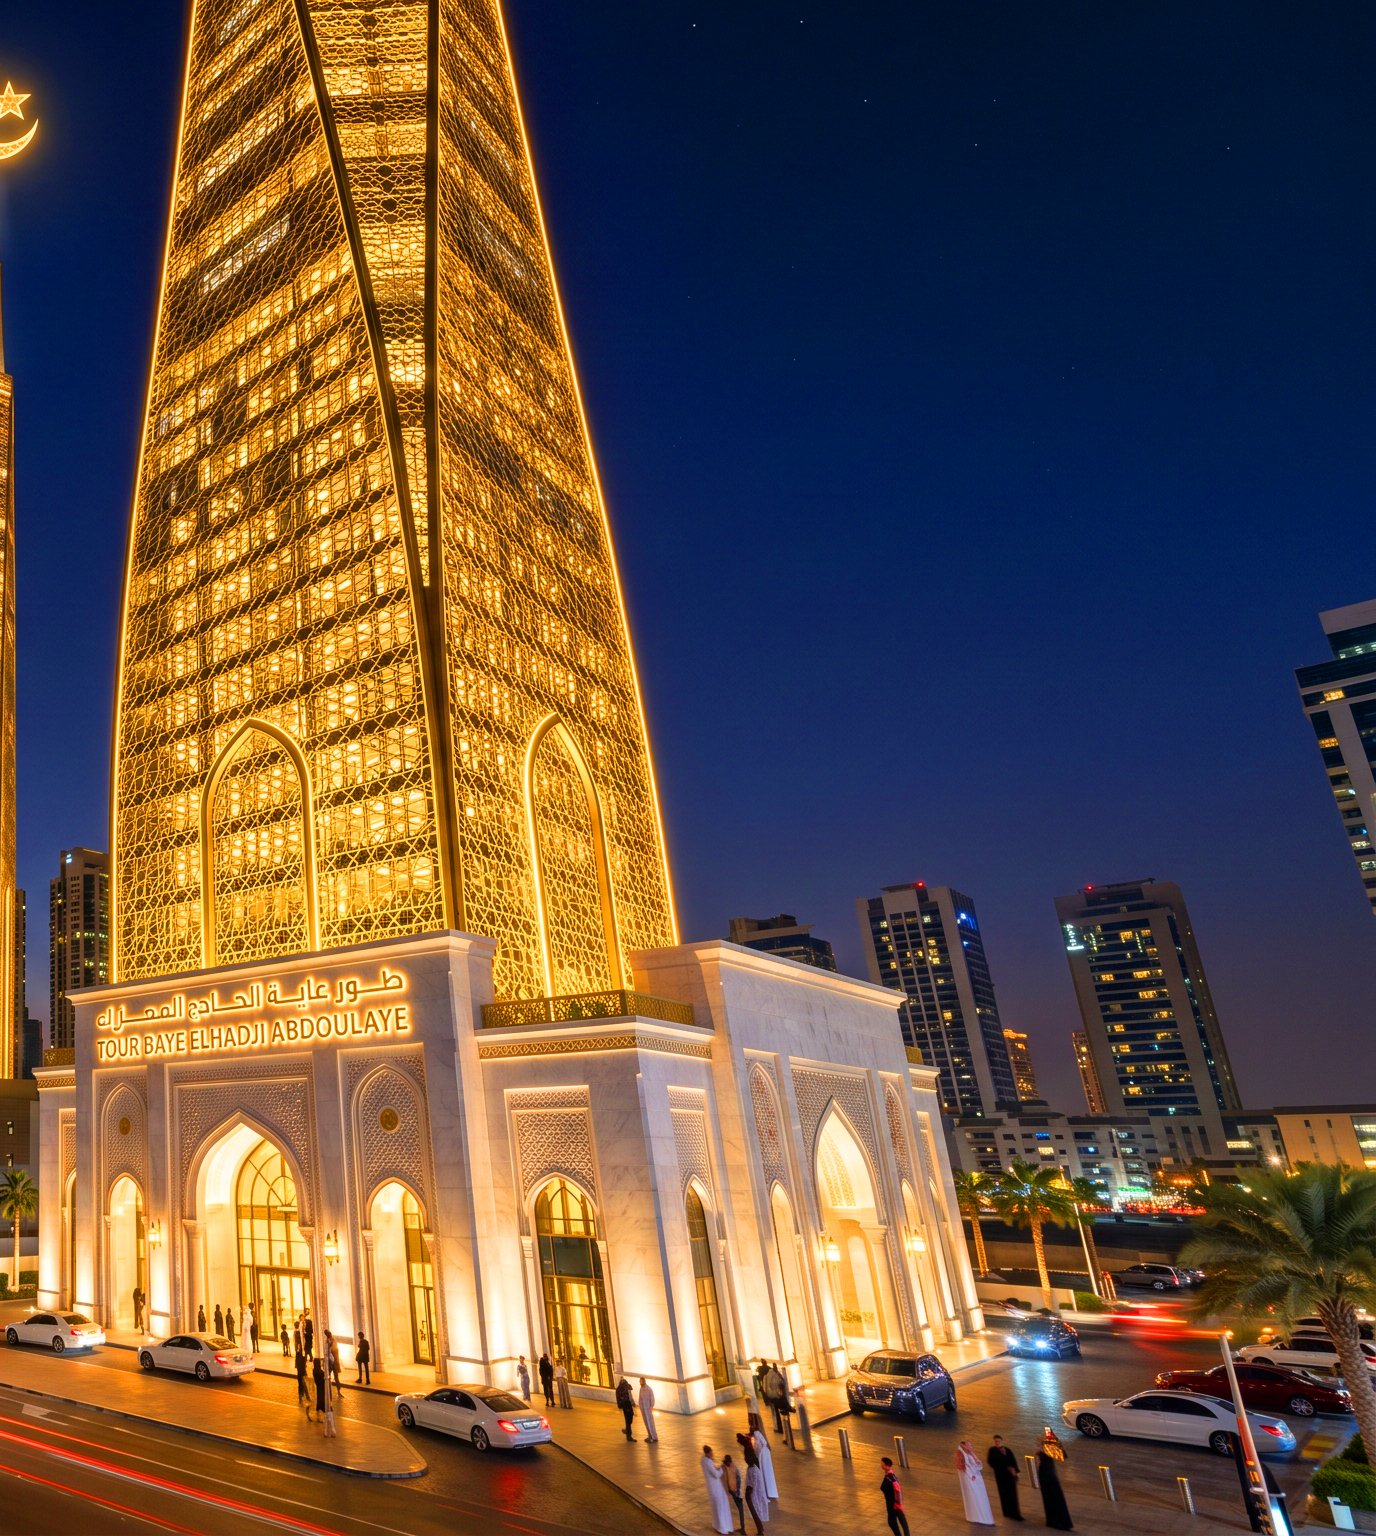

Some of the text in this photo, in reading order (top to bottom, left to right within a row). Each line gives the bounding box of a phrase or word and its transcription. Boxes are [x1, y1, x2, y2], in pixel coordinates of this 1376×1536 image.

[335, 970, 404, 1004] طور
[97, 1007, 409, 1060] TOUR BAYE ELHADJI ABDOULAYE
